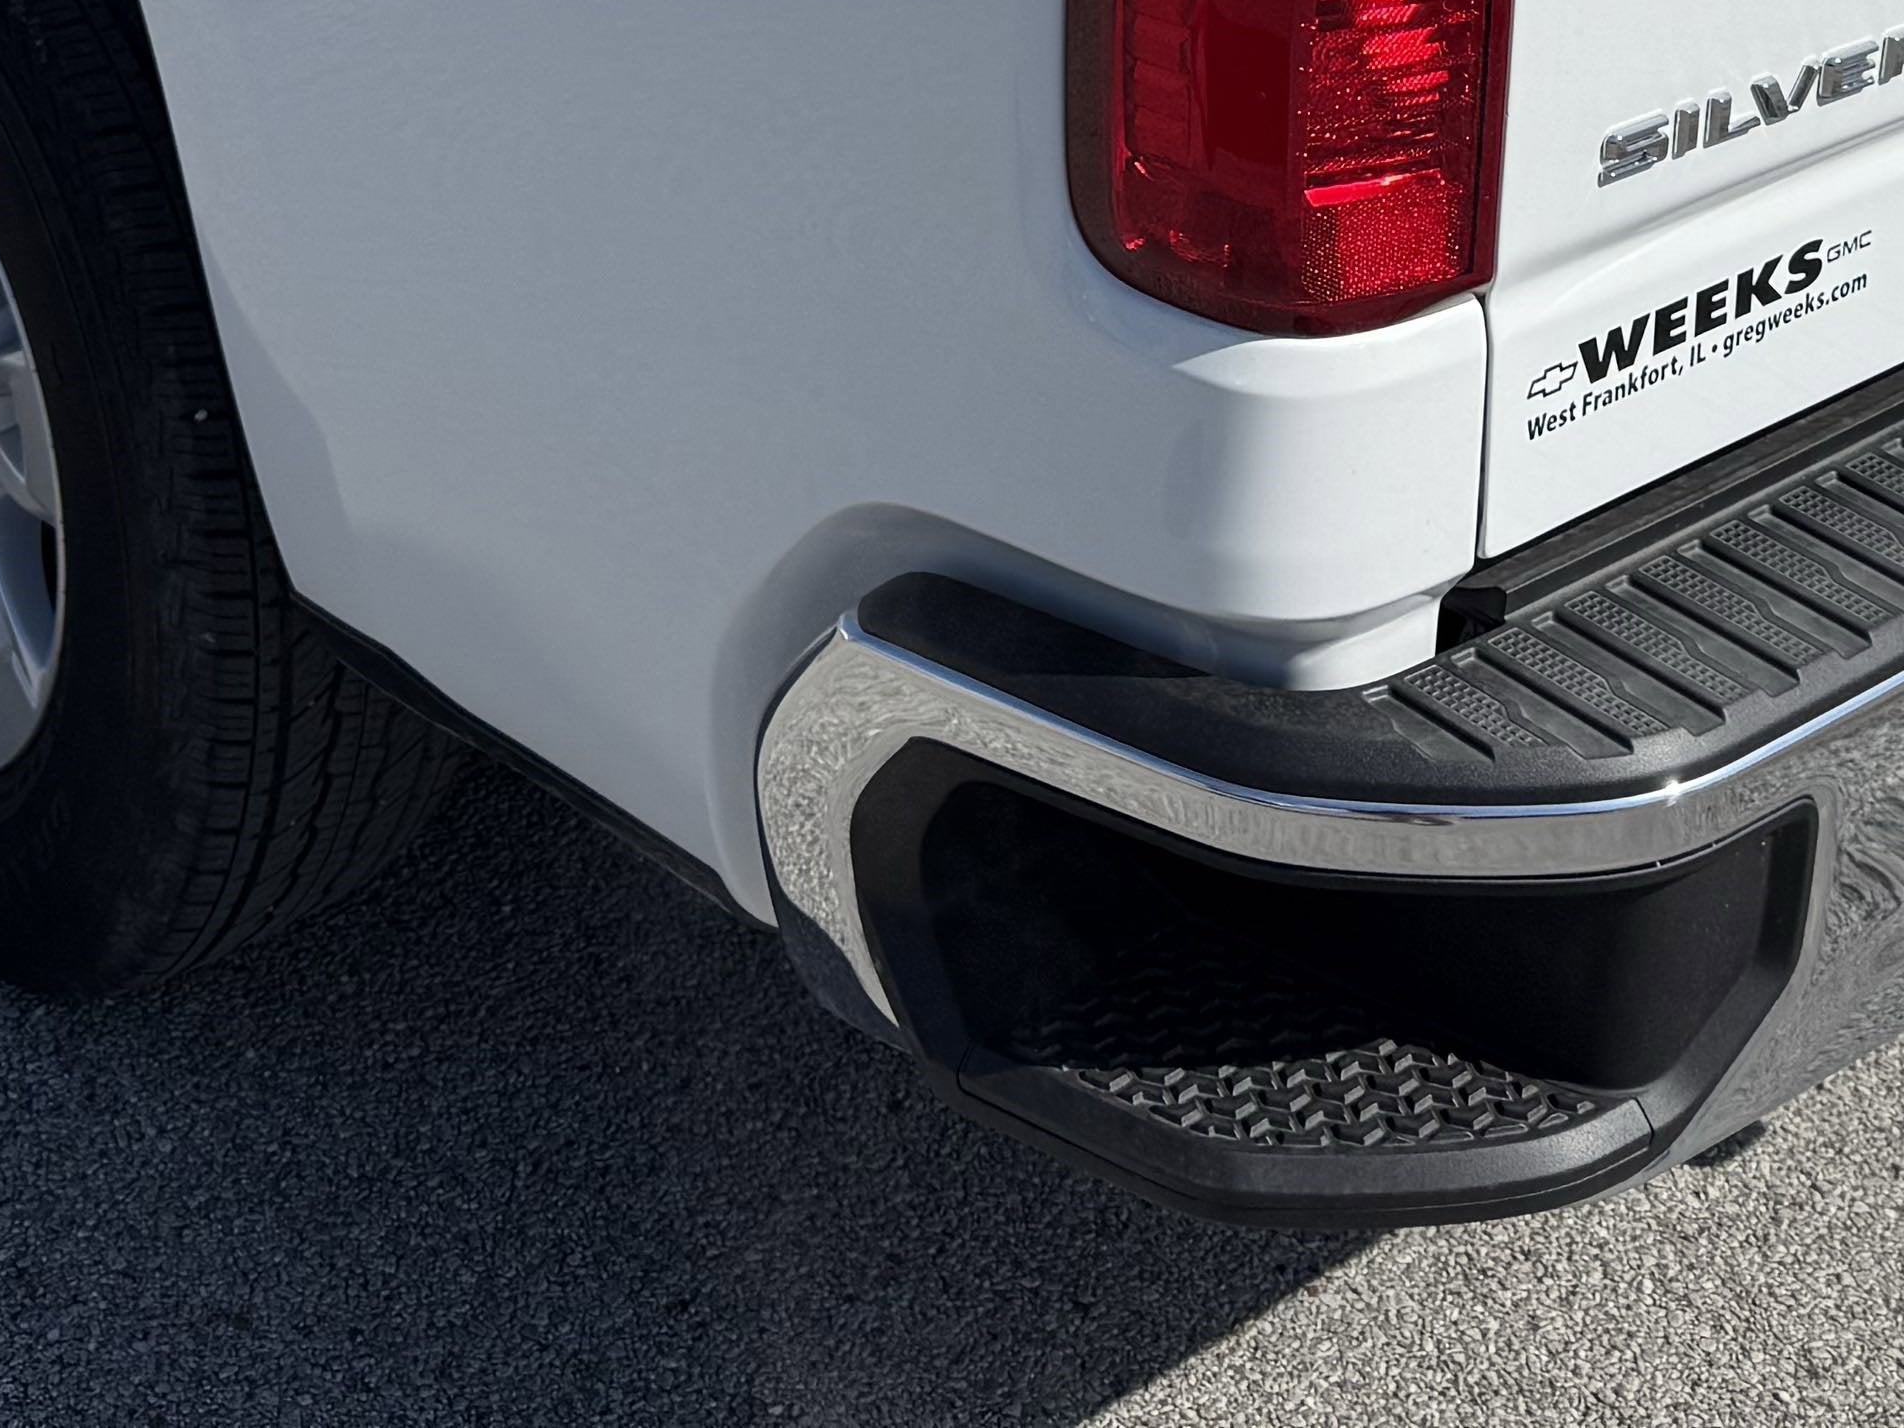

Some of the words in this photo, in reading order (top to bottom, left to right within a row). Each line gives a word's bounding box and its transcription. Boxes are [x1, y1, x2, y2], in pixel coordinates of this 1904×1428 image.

[1527, 401, 1576, 440] West
[1582, 354, 1684, 417] Frankfort,
[1689, 344, 1707, 368] IL
[1723, 272, 1868, 358] gregweeks.com
[1578, 238, 1824, 384] WEEKS
[1827, 230, 1872, 263] GMC
